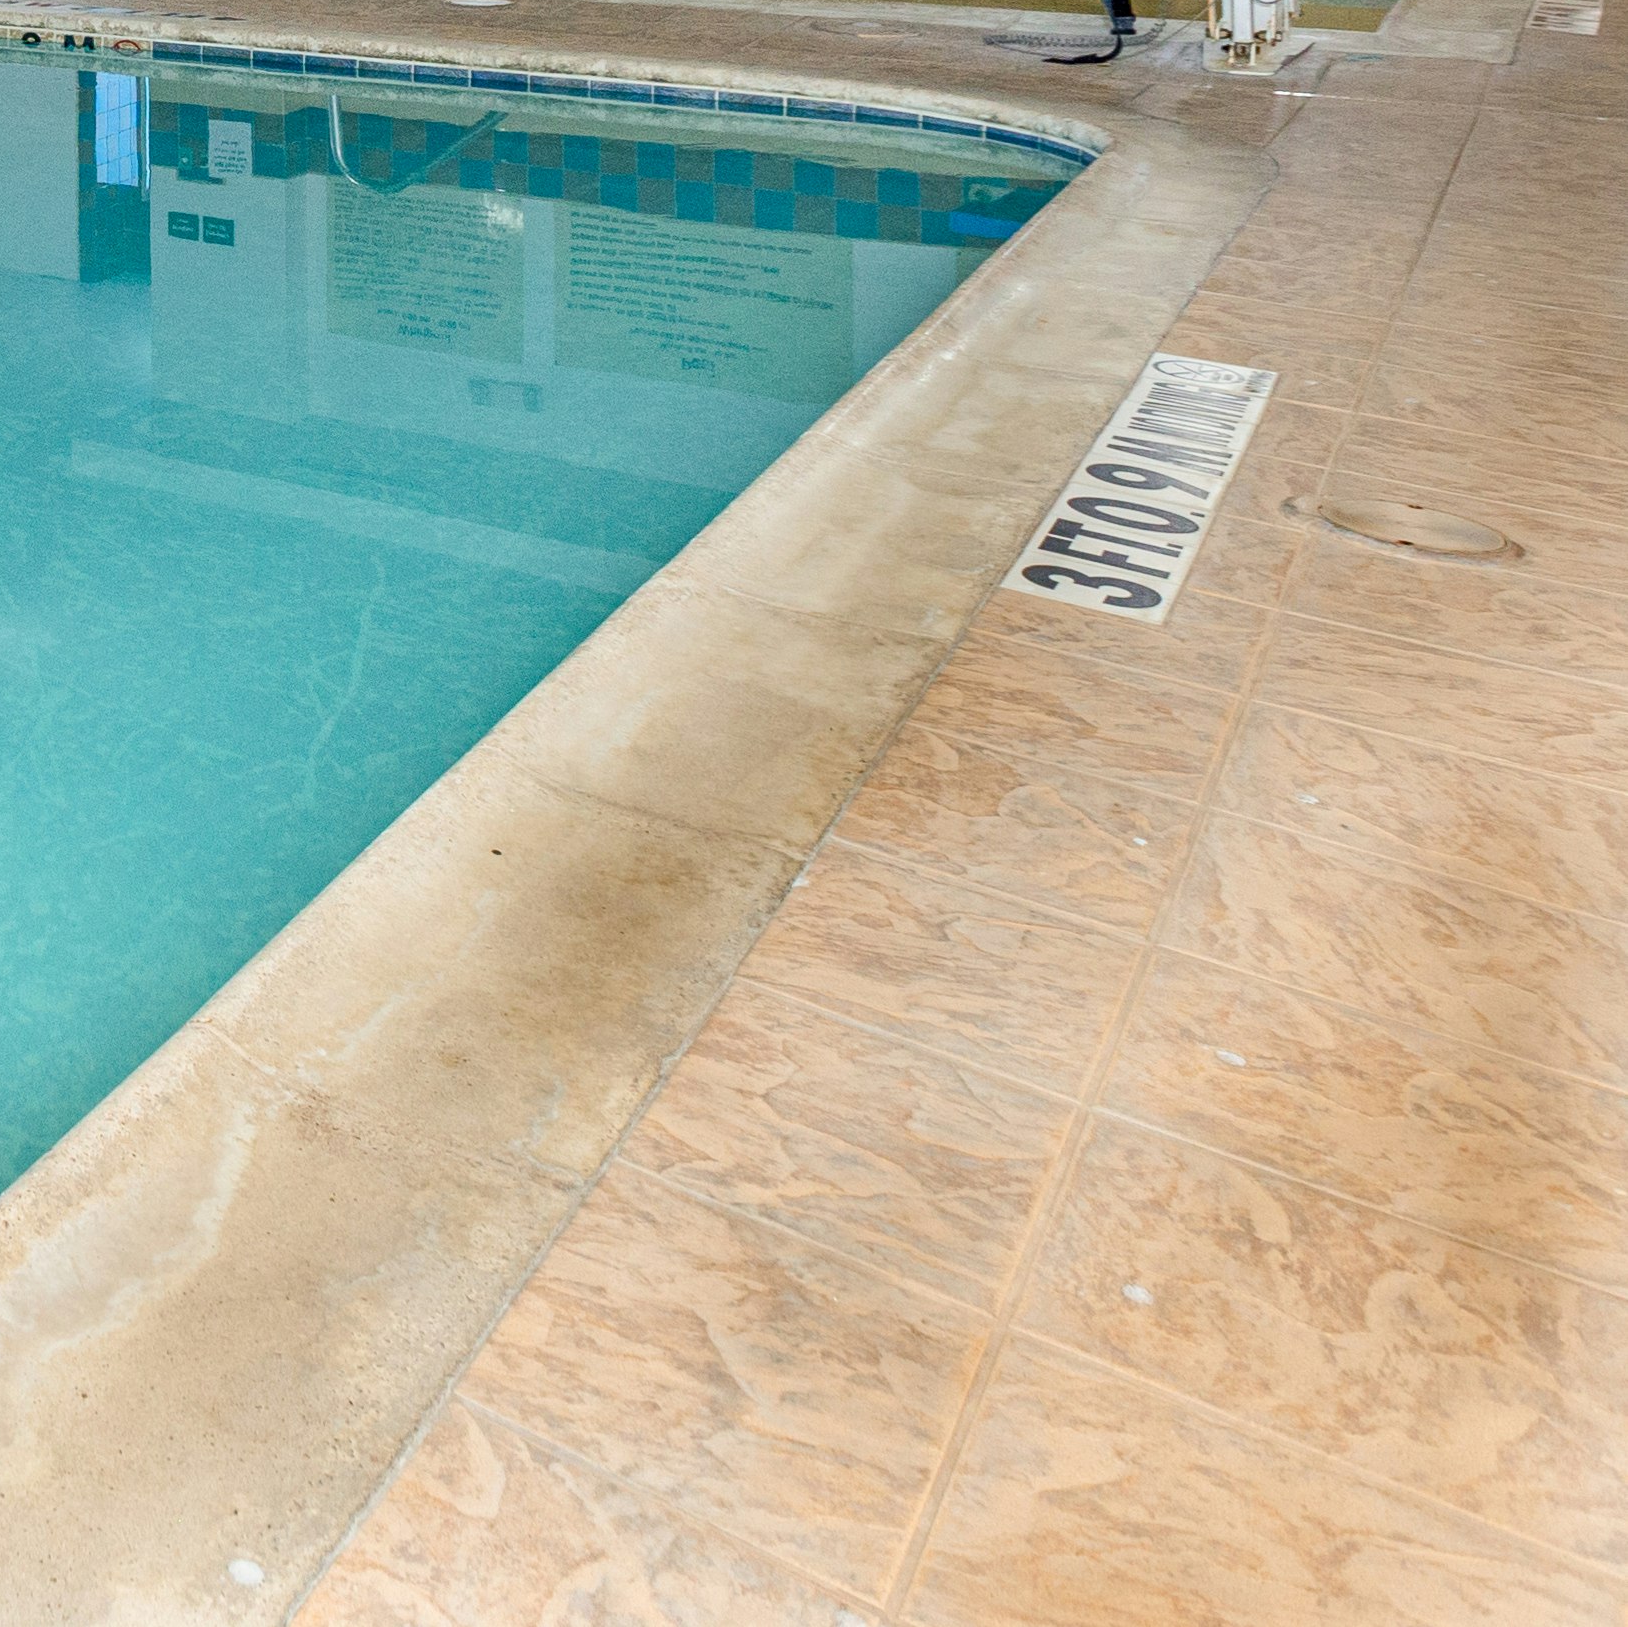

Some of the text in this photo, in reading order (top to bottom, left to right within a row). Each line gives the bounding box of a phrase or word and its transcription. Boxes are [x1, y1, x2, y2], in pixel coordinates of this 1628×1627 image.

[1136, 381, 1252, 432] DIVING
[1106, 435, 1233, 477] M
[1021, 563, 1163, 609] 3
